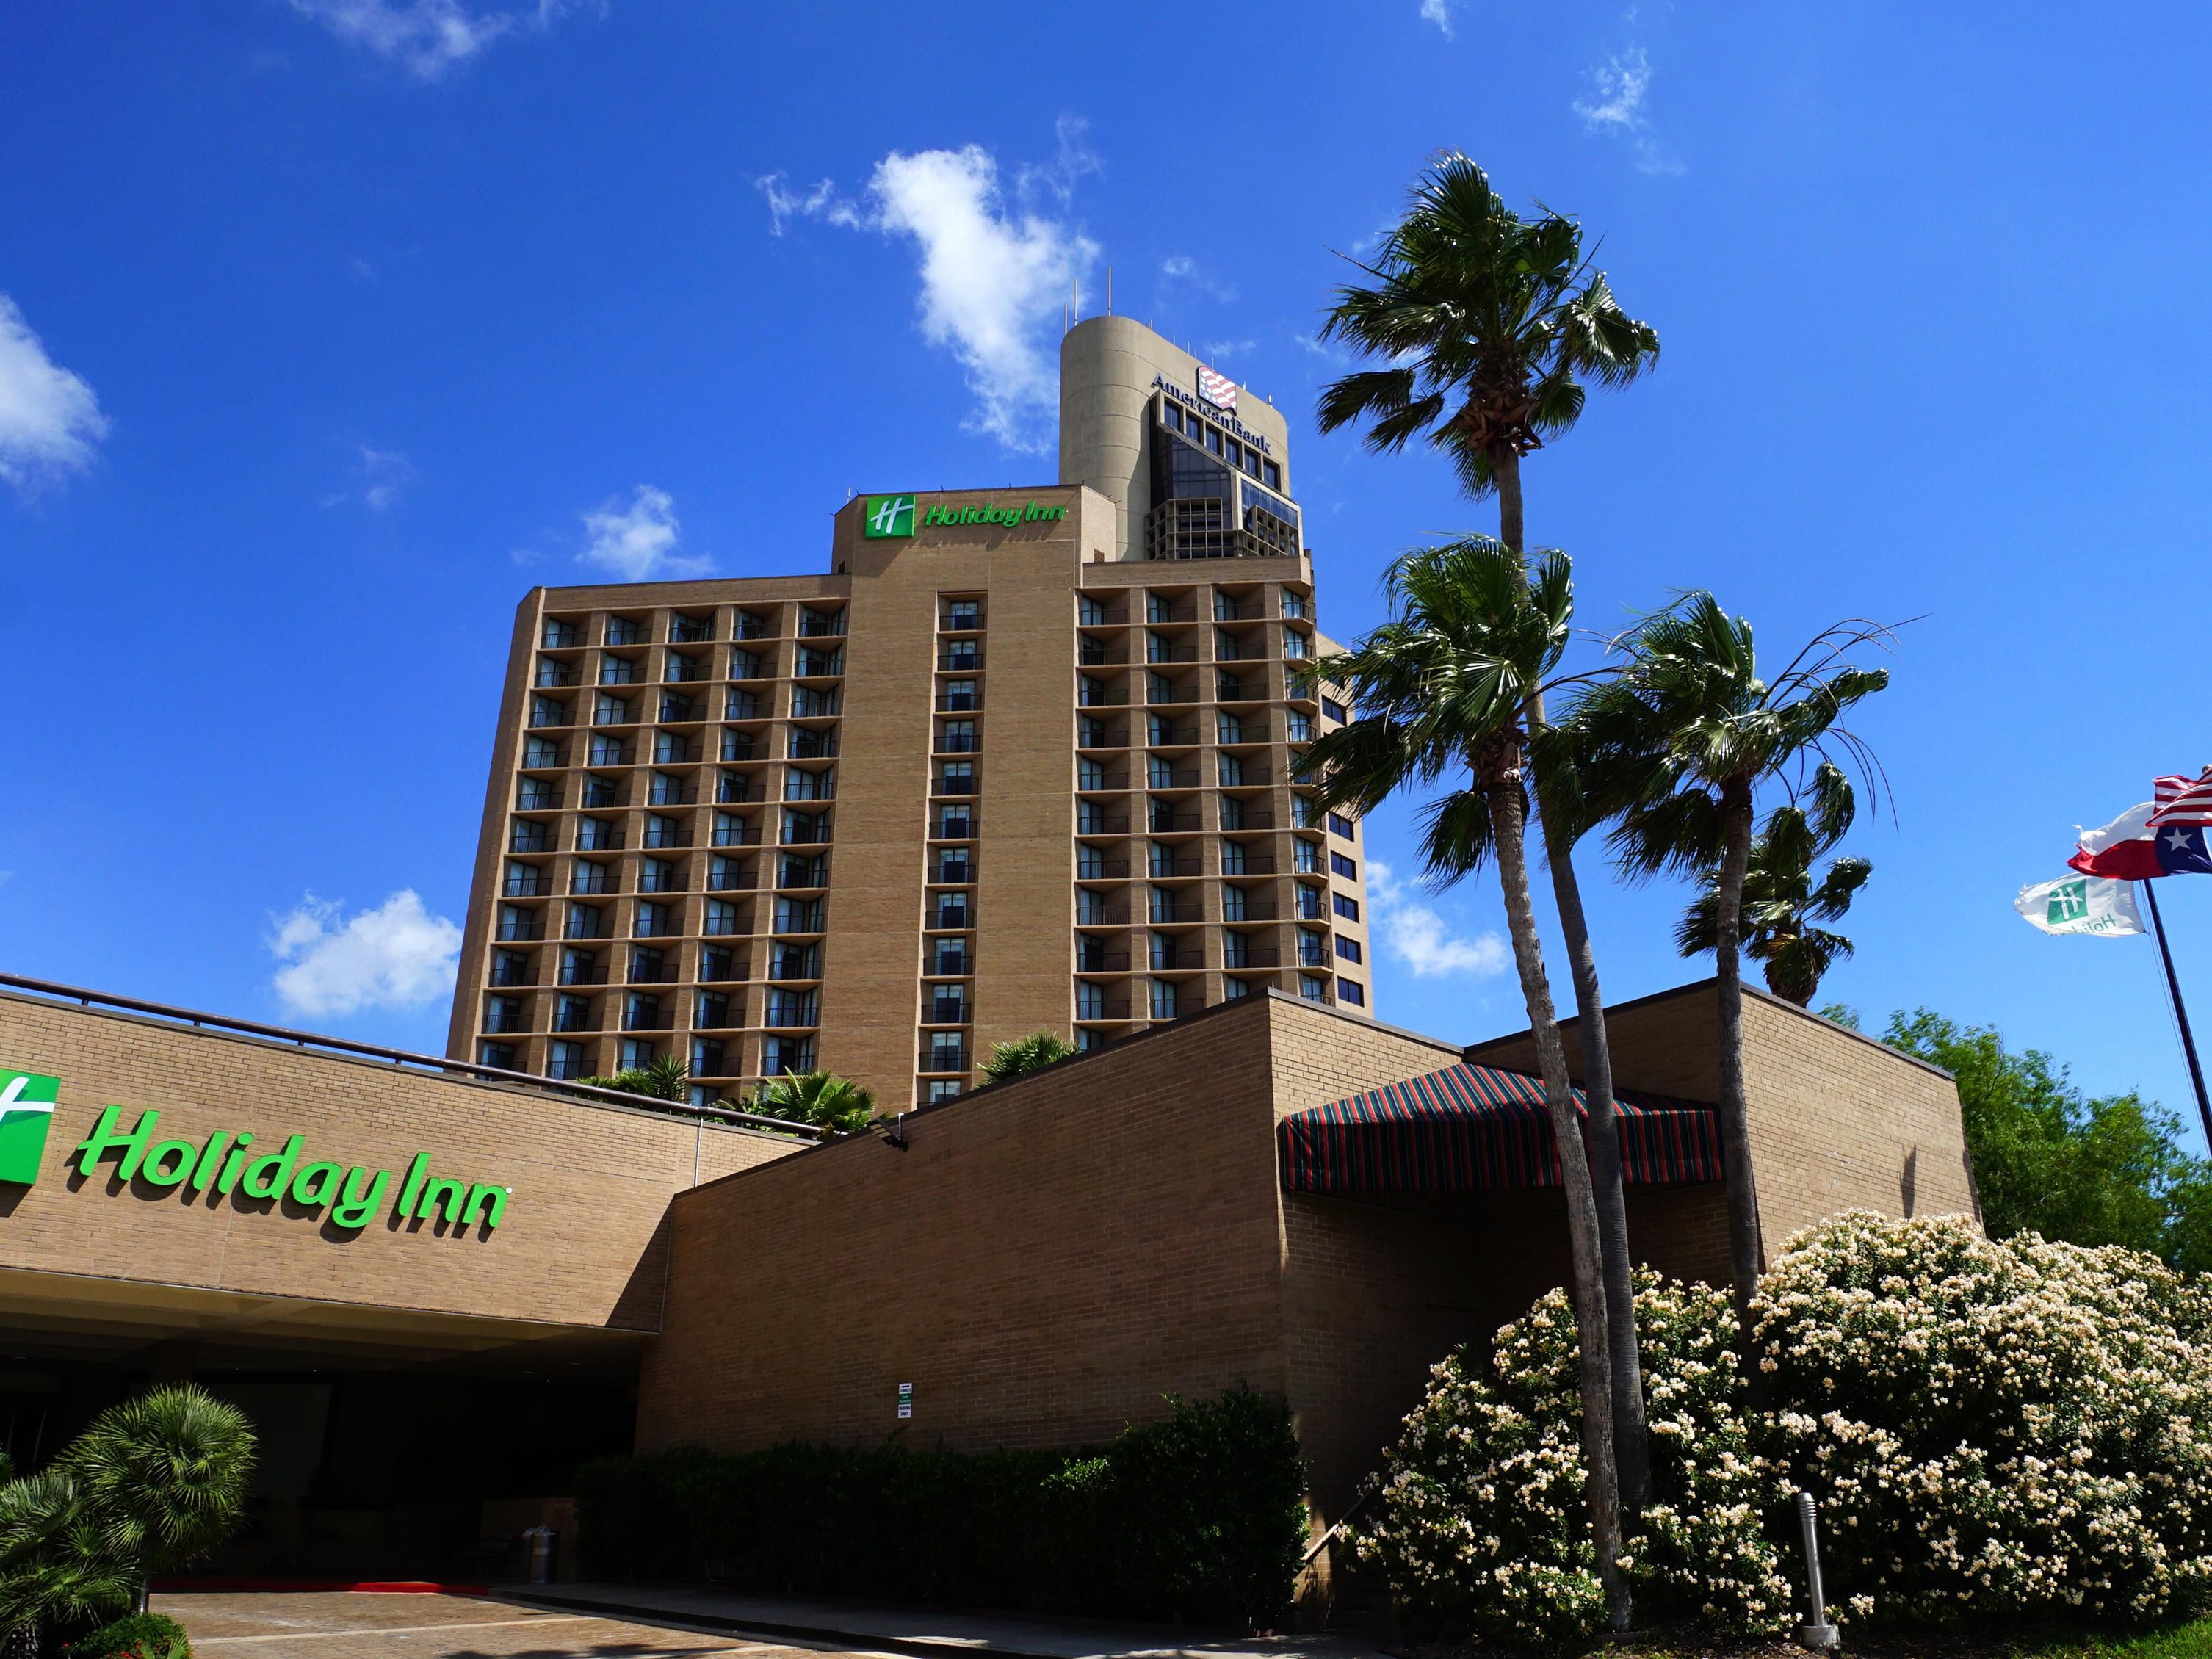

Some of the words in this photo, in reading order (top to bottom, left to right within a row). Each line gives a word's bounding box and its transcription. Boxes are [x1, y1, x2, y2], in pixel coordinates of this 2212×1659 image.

[925, 503, 1022, 528] Holiday
[1025, 499, 1065, 523] Inn
[76, 1105, 392, 1229] Holiday
[397, 1152, 509, 1229] Inn
